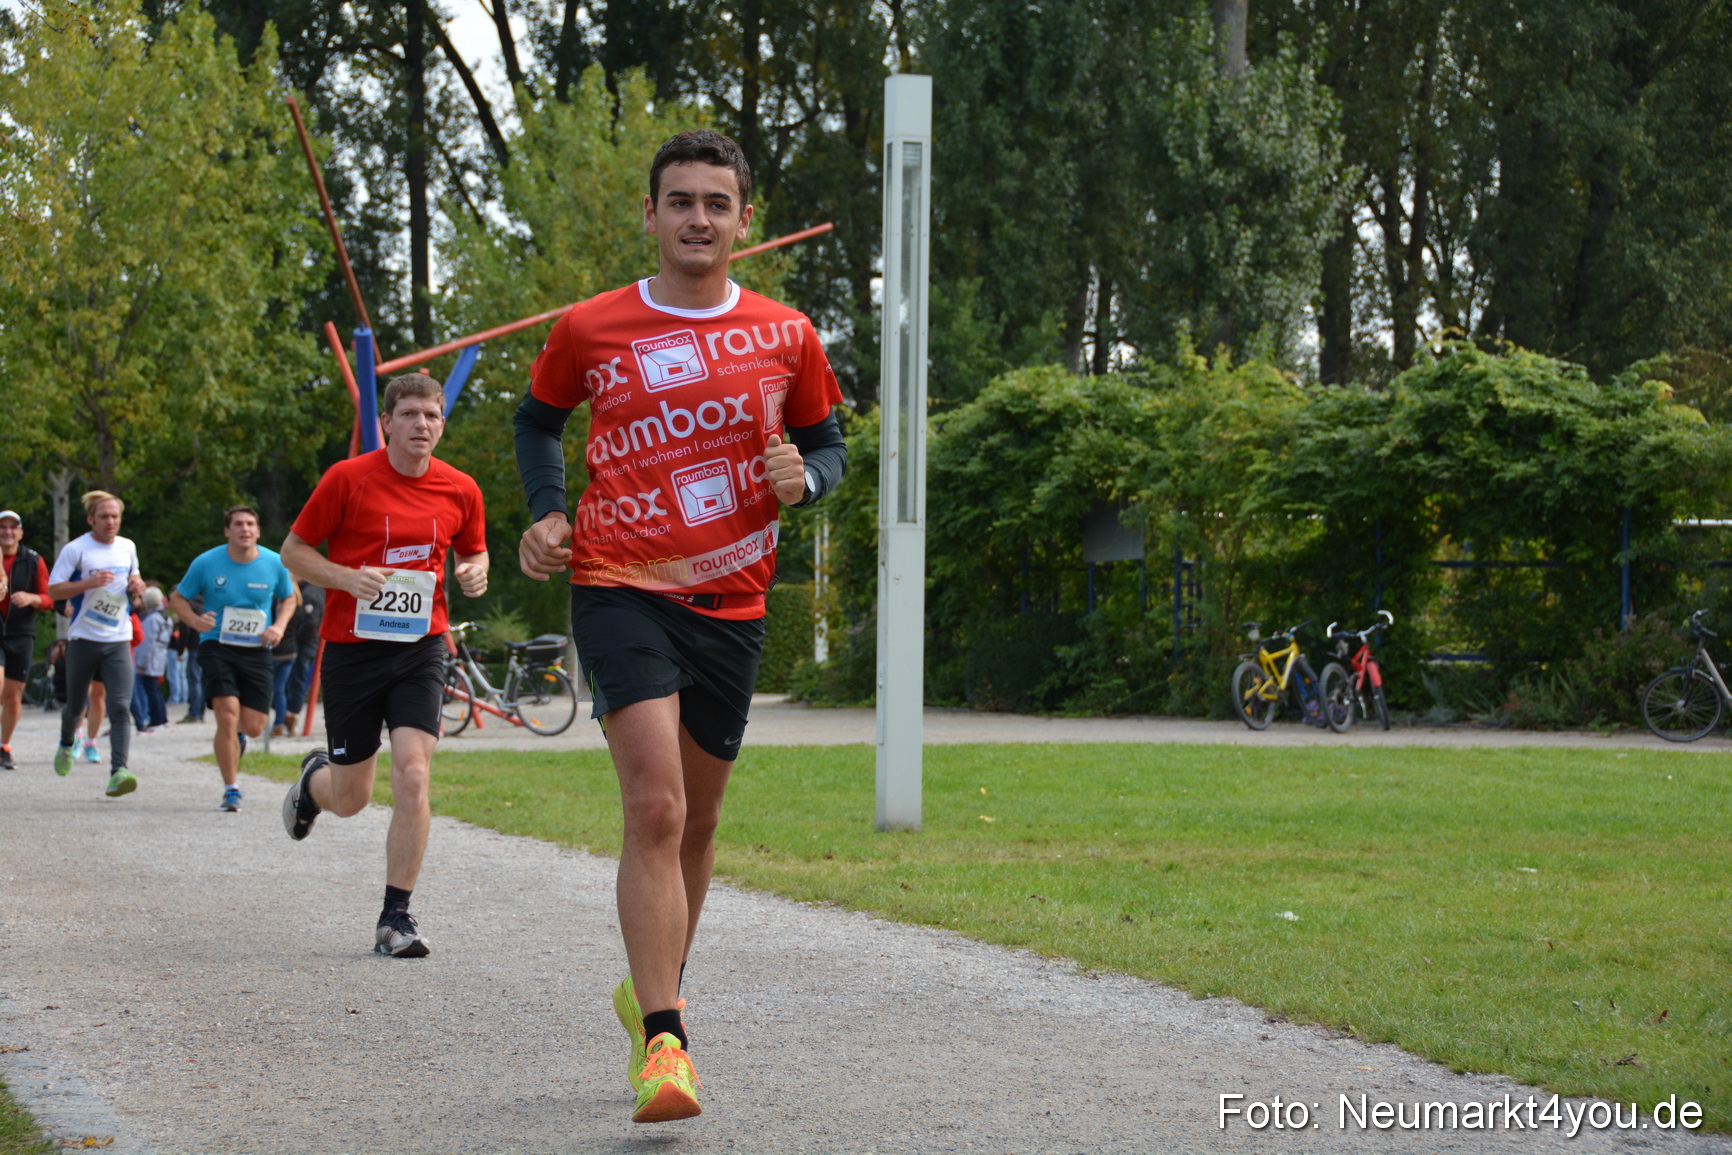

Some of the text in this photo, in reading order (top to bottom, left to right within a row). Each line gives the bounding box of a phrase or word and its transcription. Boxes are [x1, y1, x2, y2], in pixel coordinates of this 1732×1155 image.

[636, 334, 692, 354] raumbox
[717, 357, 778, 377] schenken
[638, 445, 692, 469] wohnen
[702, 428, 754, 450] outdoor
[676, 464, 726, 486] raumbox
[621, 523, 671, 540] outdoor
[399, 549, 419, 559] DEHN
[581, 555, 689, 586] Team
[692, 537, 760, 576] raumbox
[94, 599, 121, 617] 2427
[369, 591, 422, 614] 2230
[228, 619, 259, 633] 2247
[379, 619, 410, 629] Andreas
